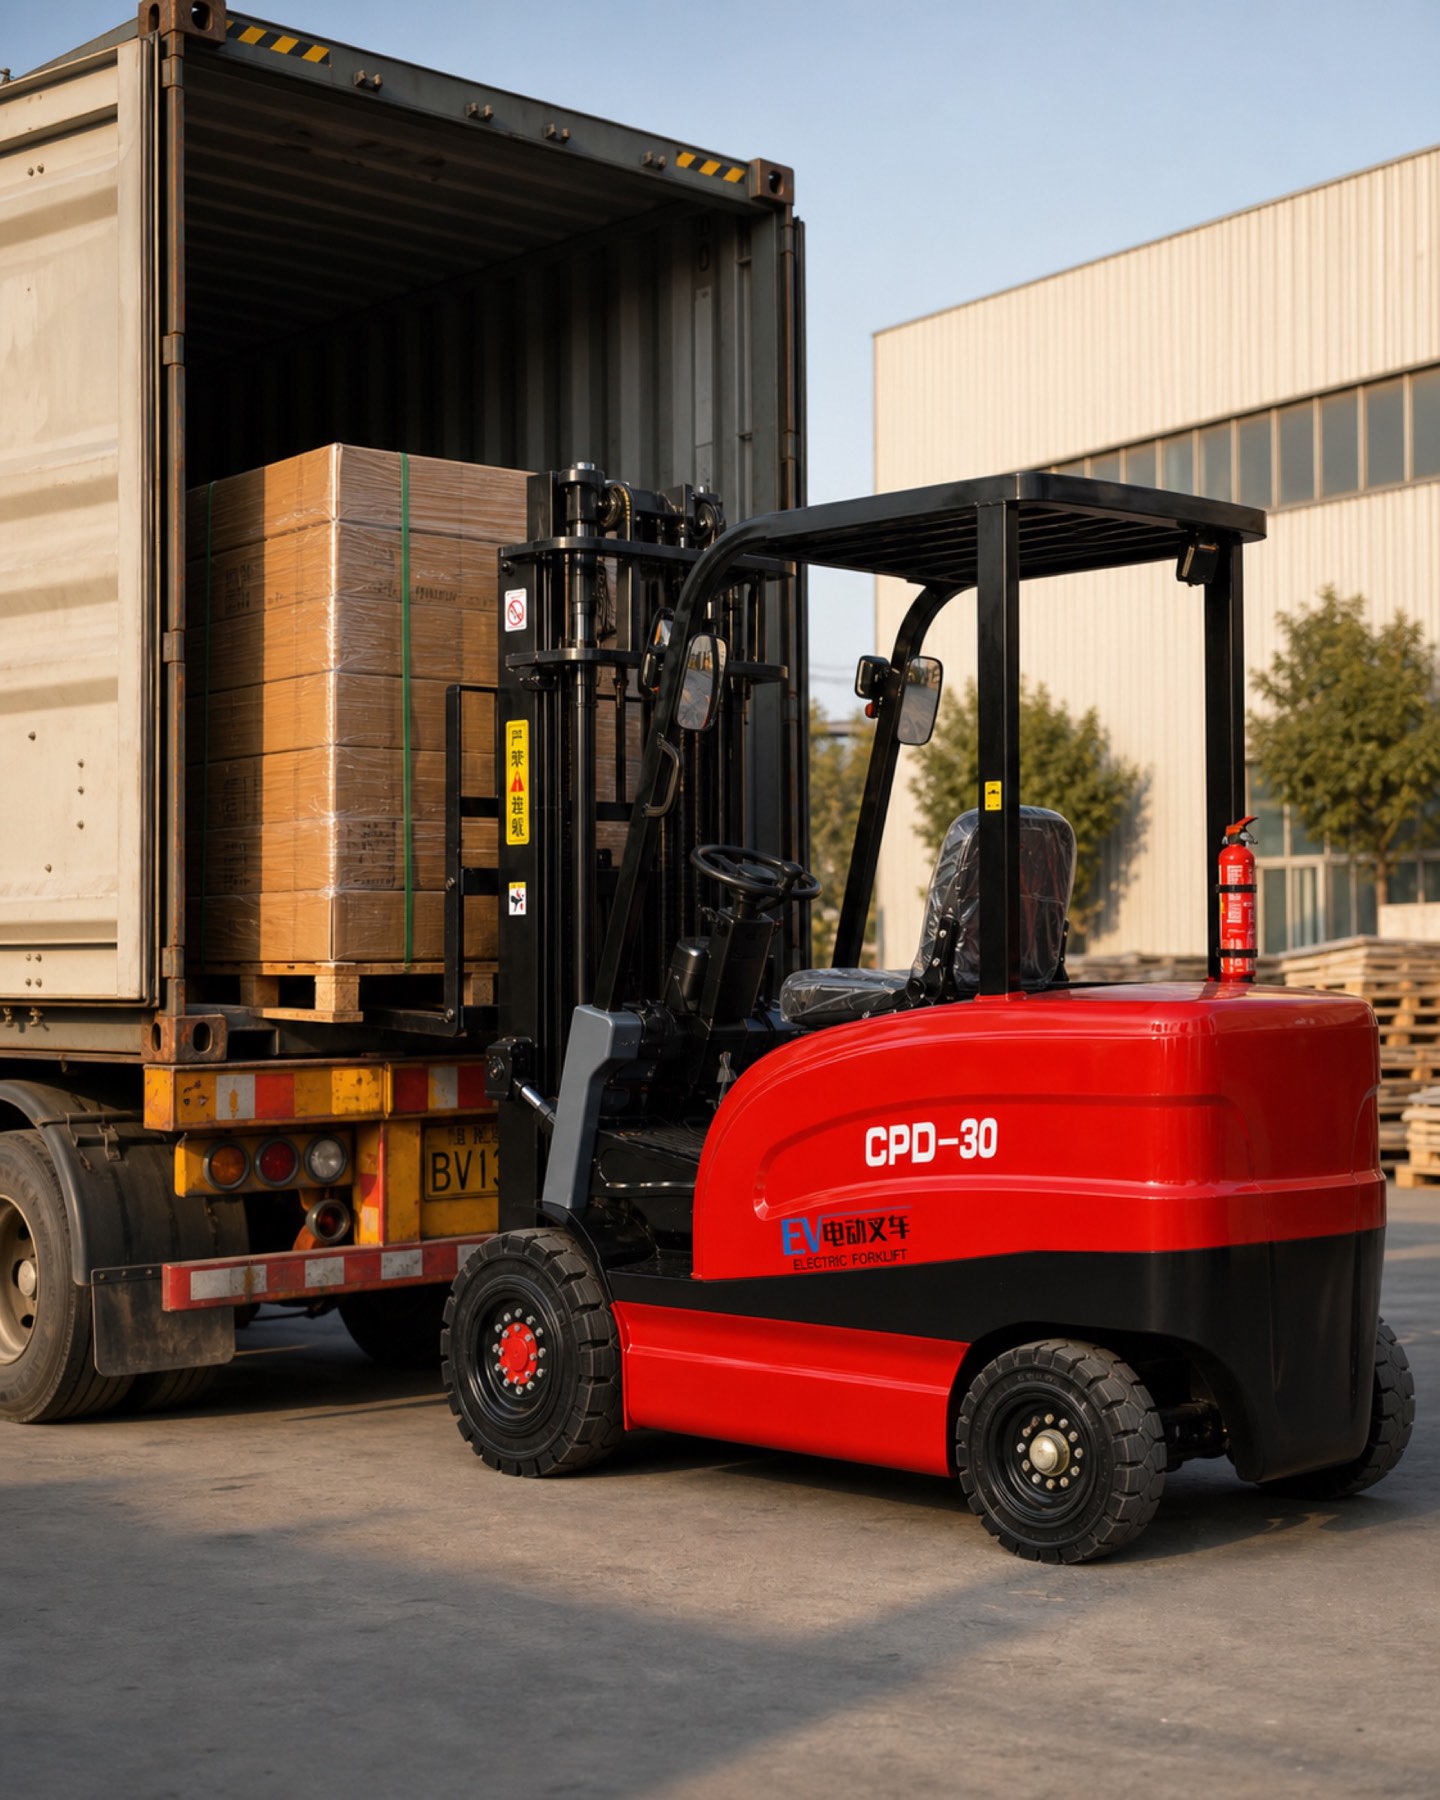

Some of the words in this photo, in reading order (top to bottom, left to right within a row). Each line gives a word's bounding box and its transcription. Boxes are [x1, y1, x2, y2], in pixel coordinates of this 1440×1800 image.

[865, 1117, 998, 1167] CPD-30
[431, 1149, 498, 1192] BV1
[793, 1255, 847, 1271] ELECTRIC
[852, 1248, 907, 1265] FORKLIFT
